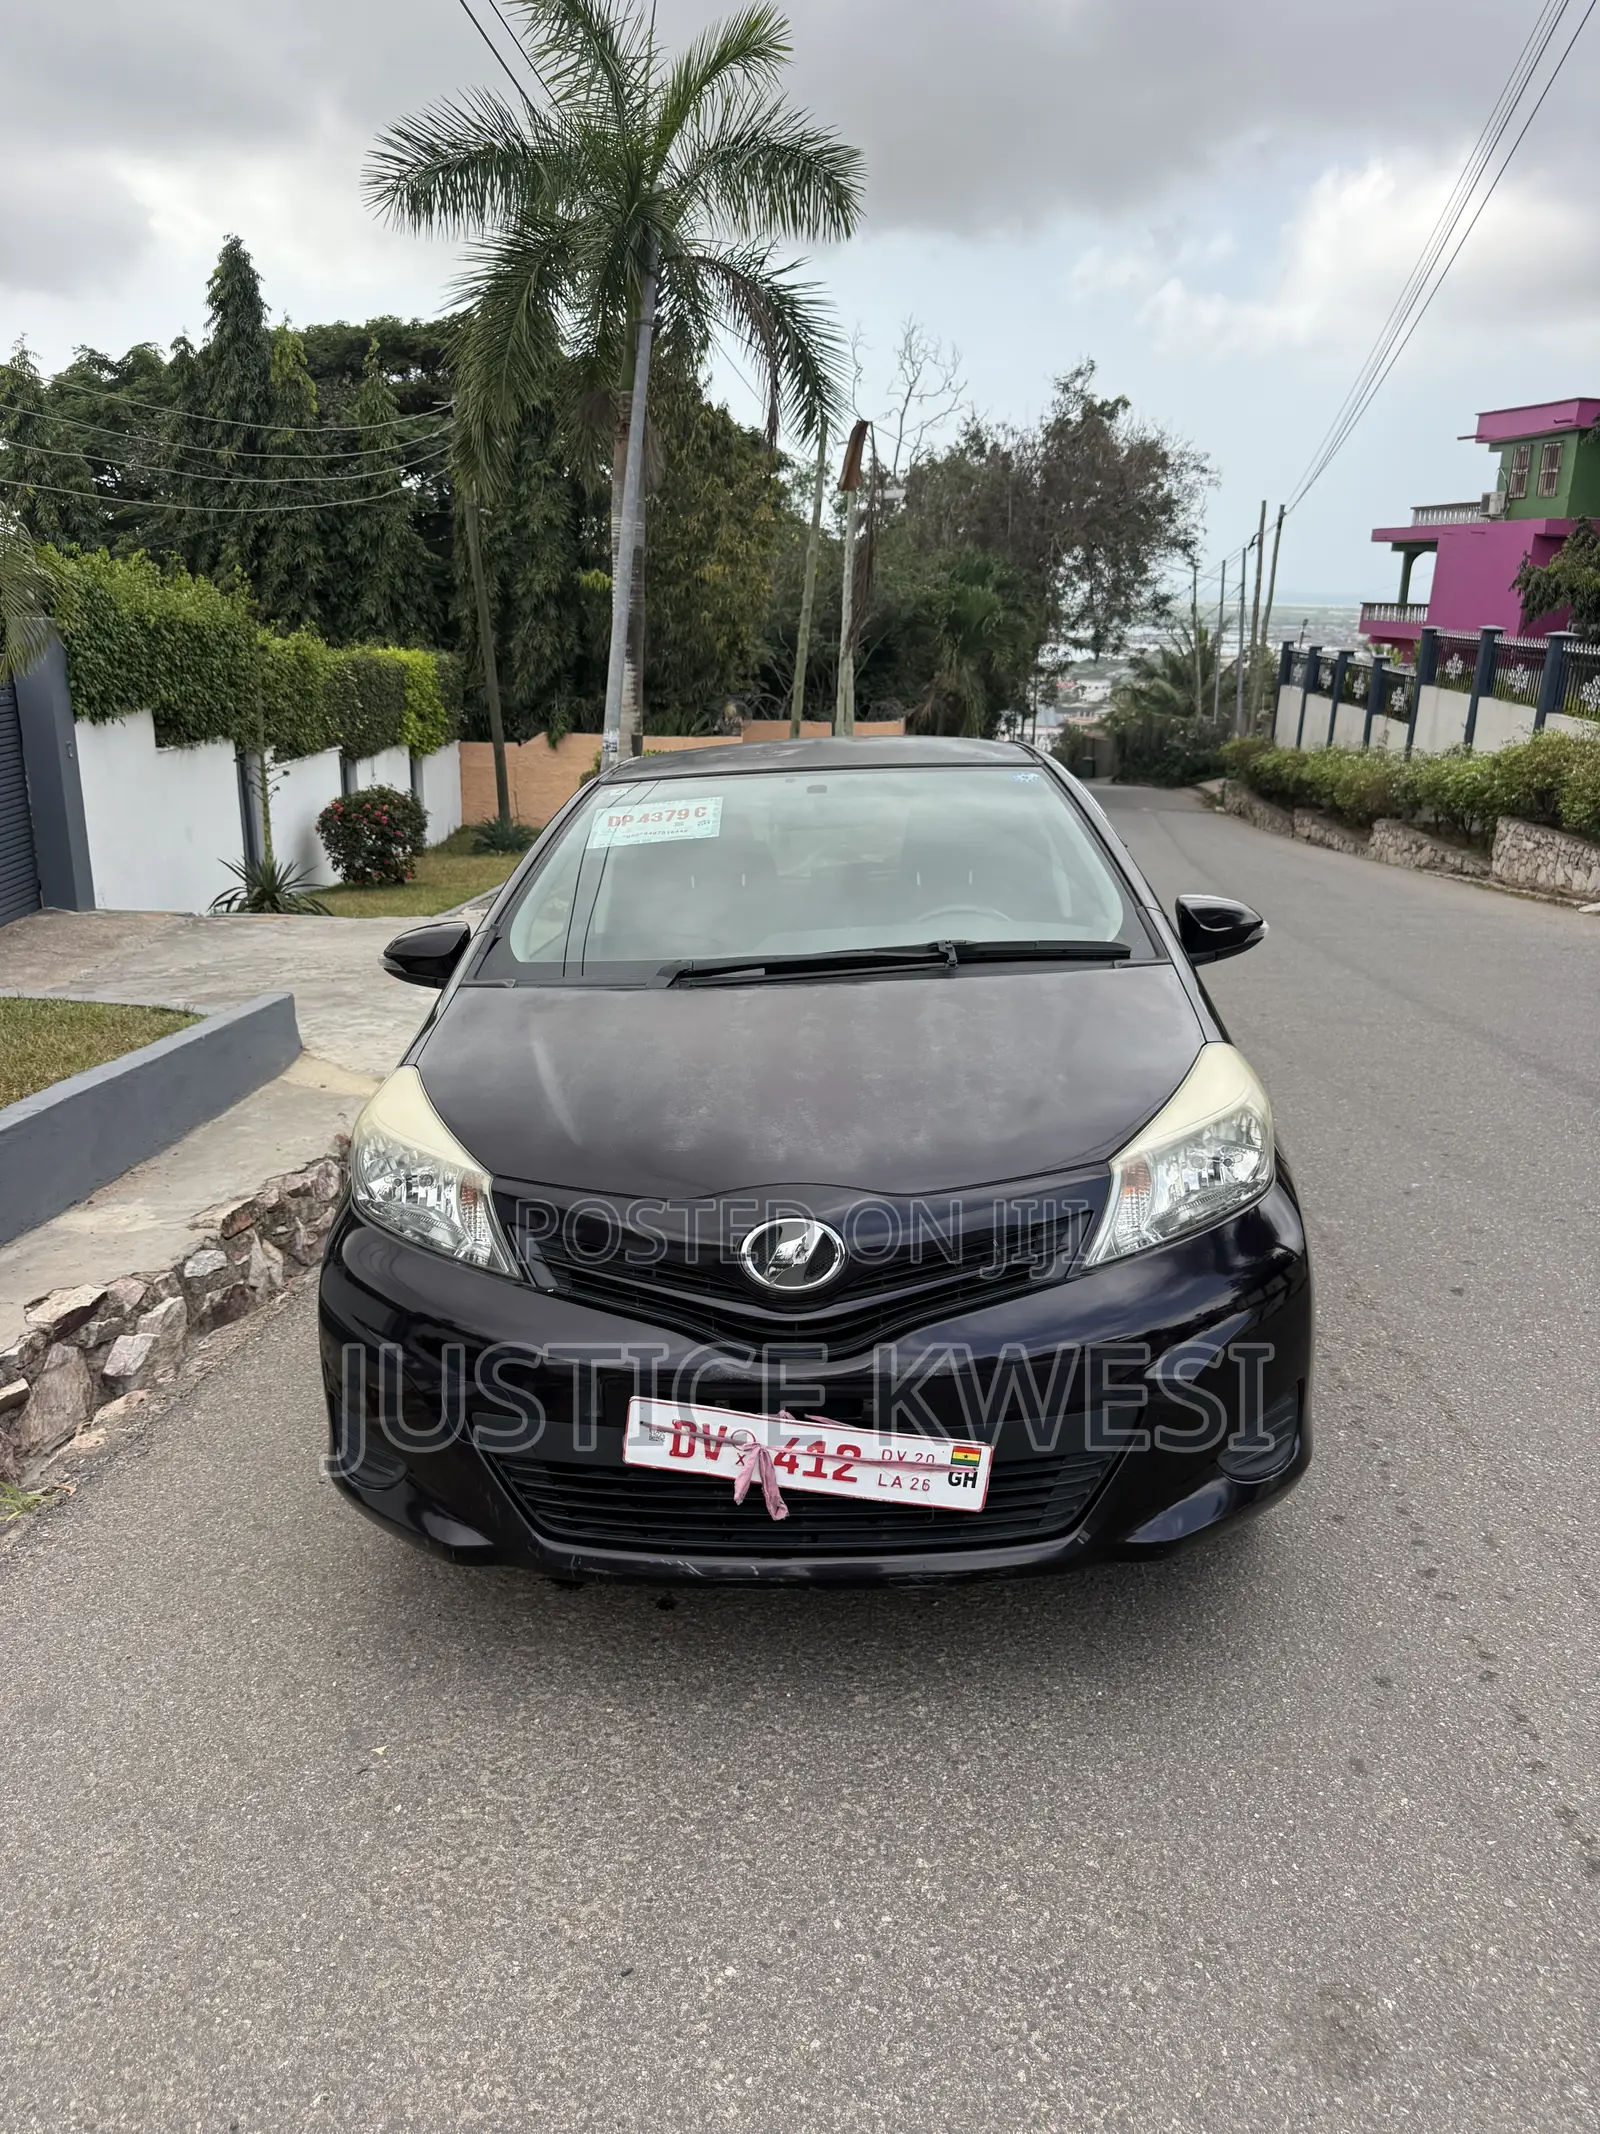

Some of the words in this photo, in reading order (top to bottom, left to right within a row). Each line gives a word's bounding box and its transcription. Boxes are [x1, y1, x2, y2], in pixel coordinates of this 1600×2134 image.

[607, 815, 634, 828] DP
[636, 808, 690, 824] 4379
[694, 806, 707, 818] C
[669, 1419, 728, 1461] DV
[774, 1437, 862, 1483] 412
[881, 1449, 907, 1463] DV
[878, 1473, 903, 1489] LA
[910, 1477, 931, 1492] 26
[948, 1471, 978, 1489] GH
